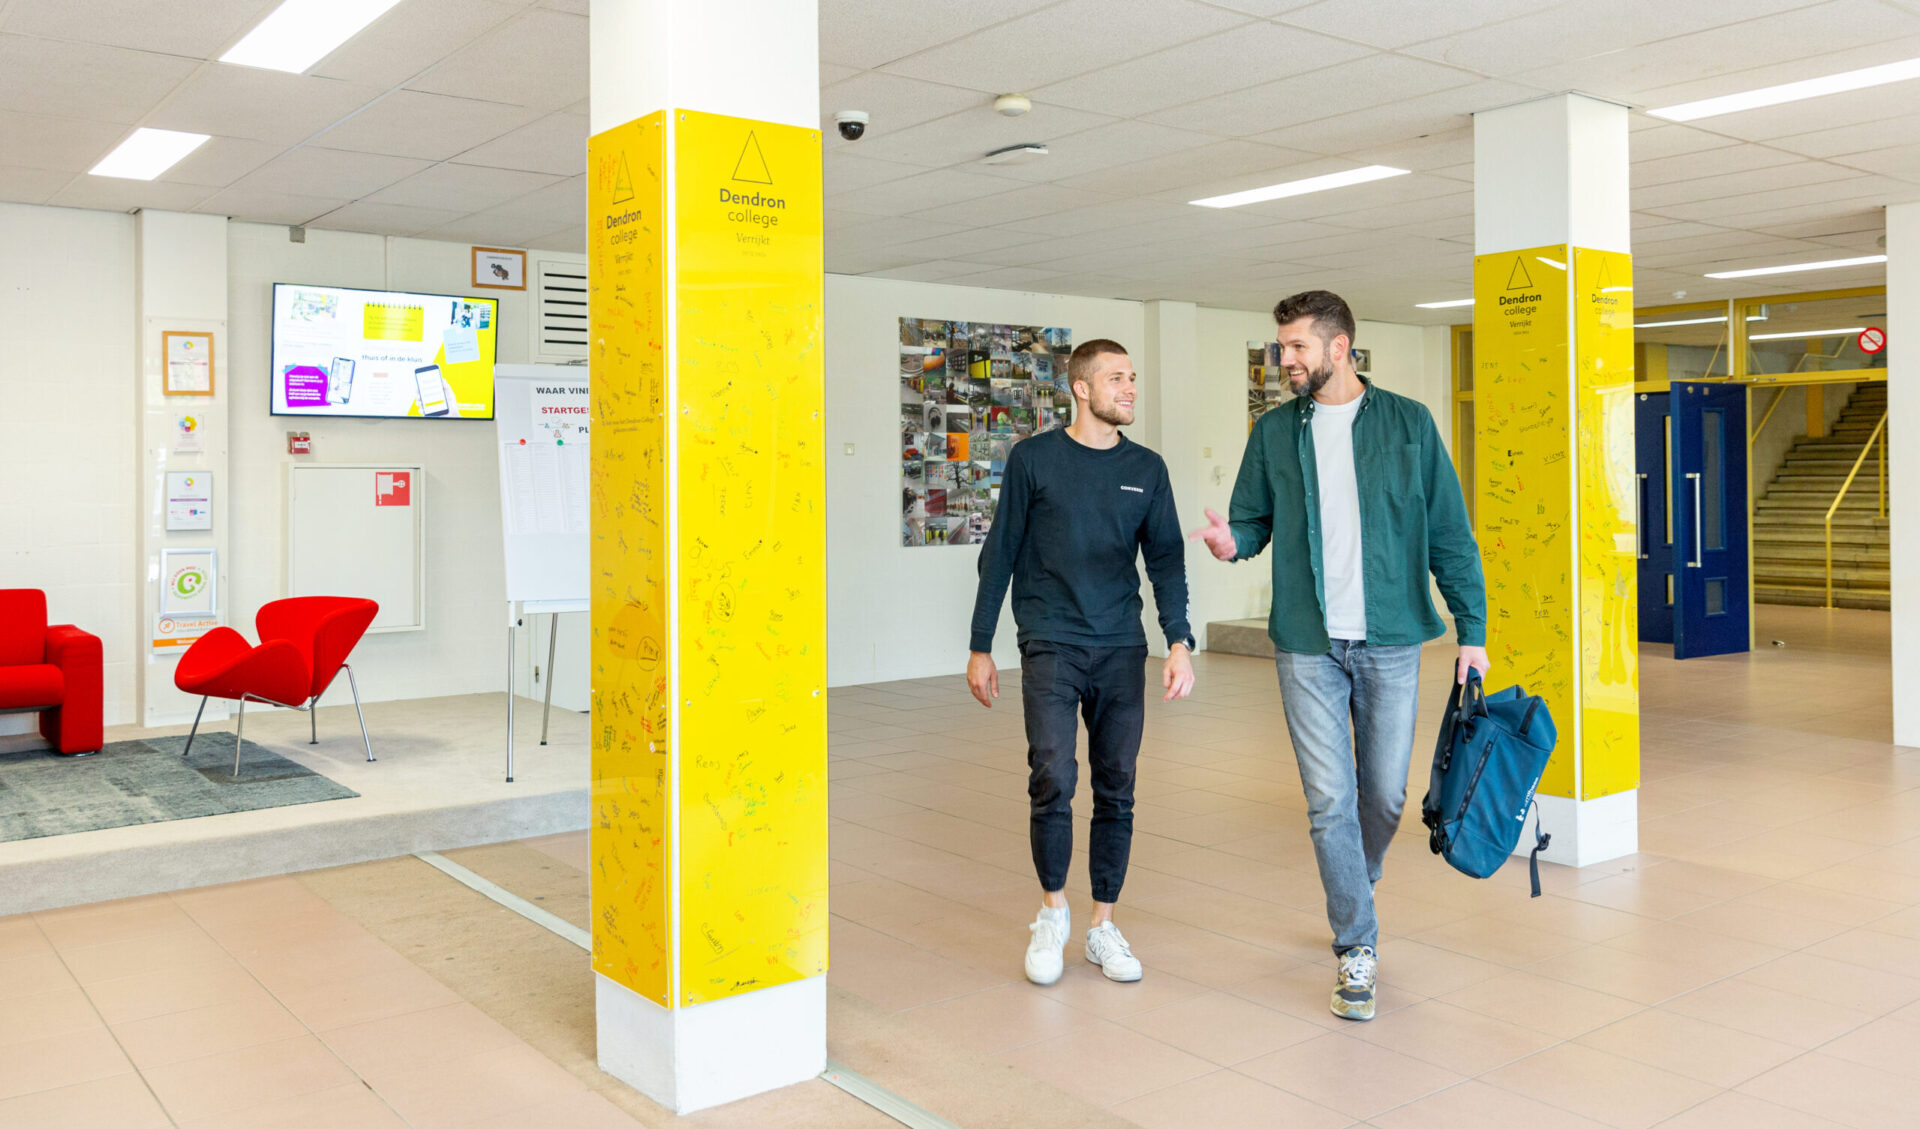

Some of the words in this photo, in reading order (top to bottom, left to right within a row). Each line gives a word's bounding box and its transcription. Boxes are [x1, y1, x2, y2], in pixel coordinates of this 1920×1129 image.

[719, 188, 786, 209] Dendron
[606, 208, 642, 230] Dendron
[727, 209, 779, 229] college
[610, 228, 638, 246] college
[736, 231, 770, 246] Verrijkt
[1498, 292, 1542, 306] Dendron
[1591, 293, 1619, 305] Dendron
[1504, 305, 1537, 316] college
[536, 387, 566, 395] WAAR
[541, 406, 589, 414] STARTGE
